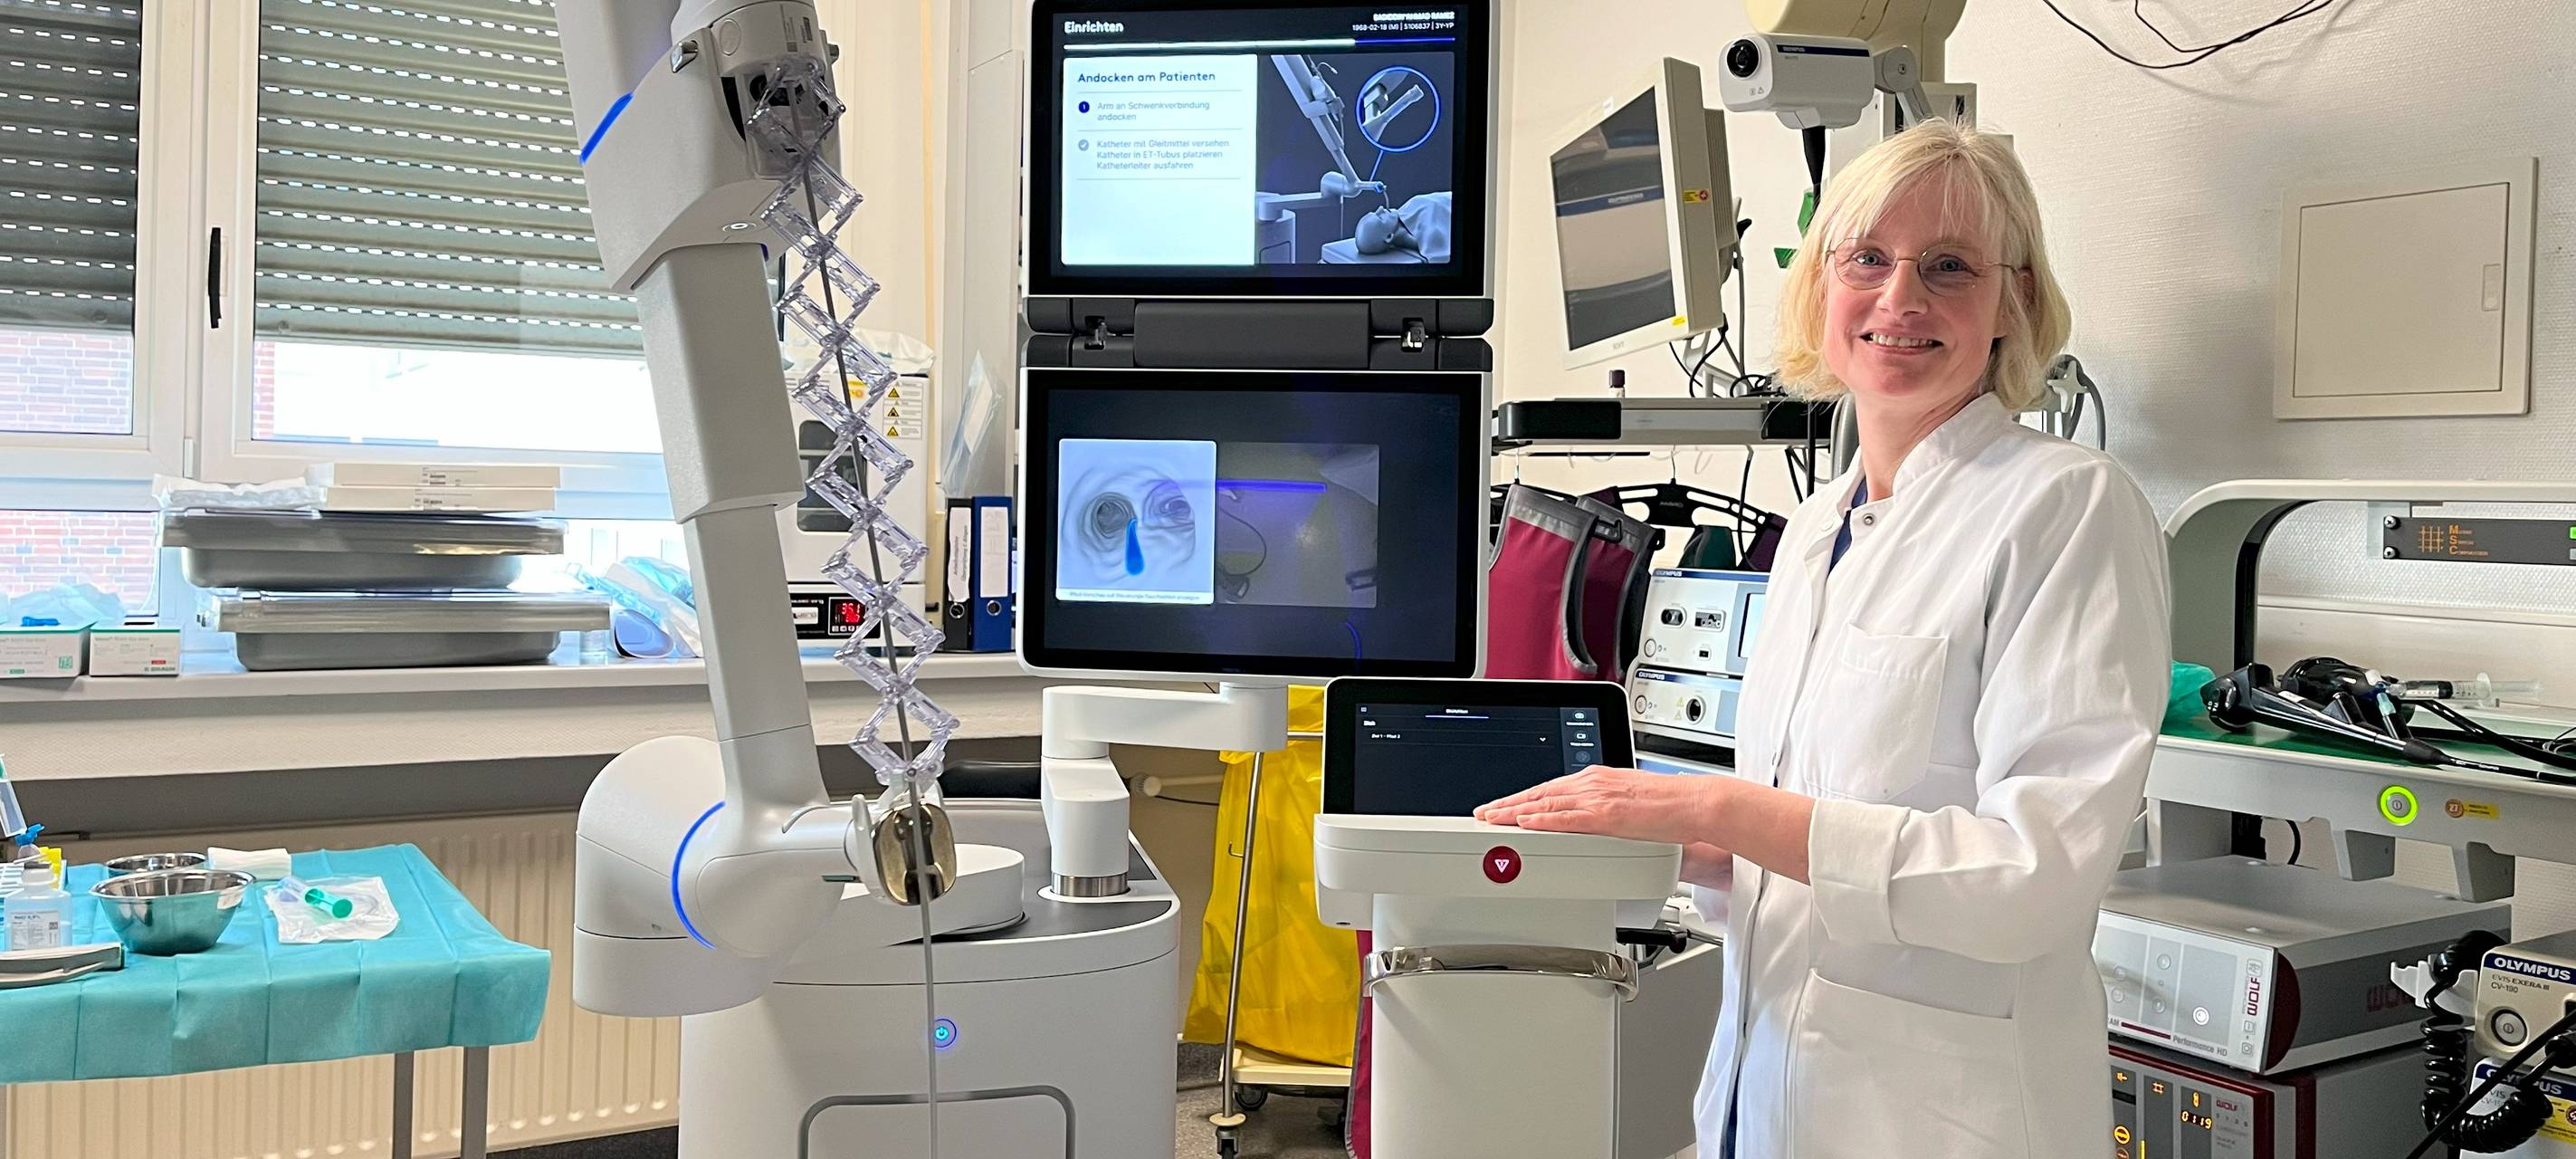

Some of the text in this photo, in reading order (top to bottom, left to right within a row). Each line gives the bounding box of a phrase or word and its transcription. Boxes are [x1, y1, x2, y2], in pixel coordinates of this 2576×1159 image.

[1064, 21, 1124, 34] Einrichten
[1078, 72, 1216, 82] Andocken am Patienten
[1128, 101, 1210, 110] Schwenkverbindung
[1149, 139, 1189, 148] Gleitmittel
[1192, 139, 1229, 148] versehen
[1143, 150, 1180, 158] ET-Tubus
[1183, 150, 1223, 159] platzieren
[1154, 161, 1194, 169] ausfahren
[2494, 957, 2571, 982] OLYMPUS
[2513, 977, 2543, 990] EXERA
[2247, 977, 2261, 1016] WOLF
[2172, 1034, 2228, 1057] Performance HD
